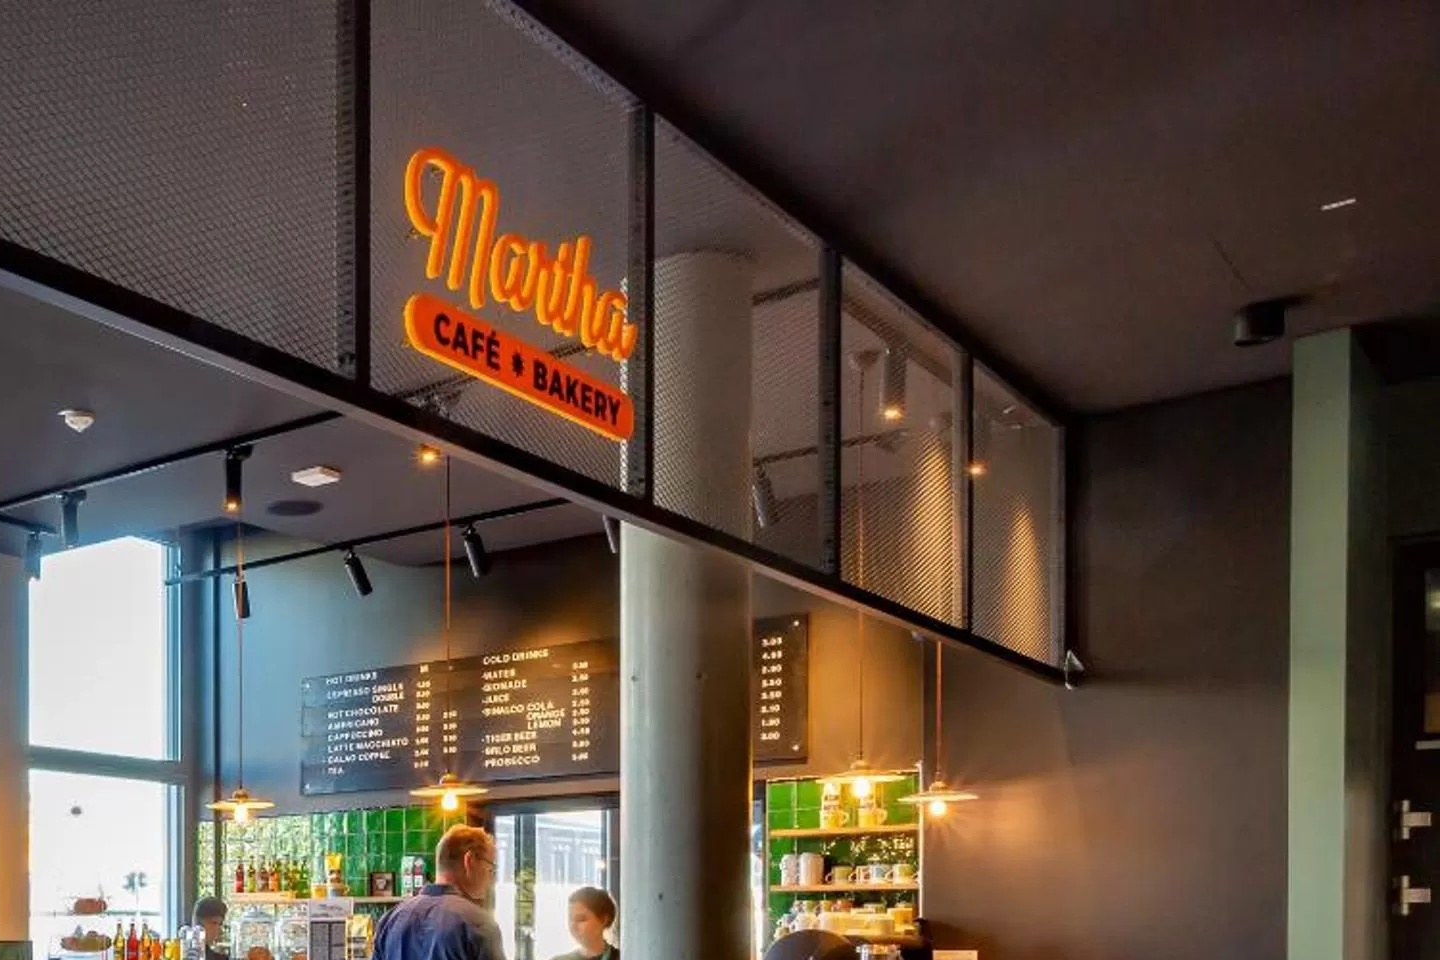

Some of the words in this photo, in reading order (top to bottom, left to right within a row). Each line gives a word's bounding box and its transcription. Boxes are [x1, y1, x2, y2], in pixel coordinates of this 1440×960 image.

[433, 312, 501, 372] CAFÉ
[532, 360, 621, 426] BAKERY
[483, 654, 510, 665] COLD
[512, 648, 549, 662] DRINKS
[345, 704, 399, 717] CHOCOLATE
[526, 700, 554, 711] COLA
[526, 708, 566, 721] ORANGE
[527, 718, 562, 730] LEMON
[327, 743, 354, 753] LATTE
